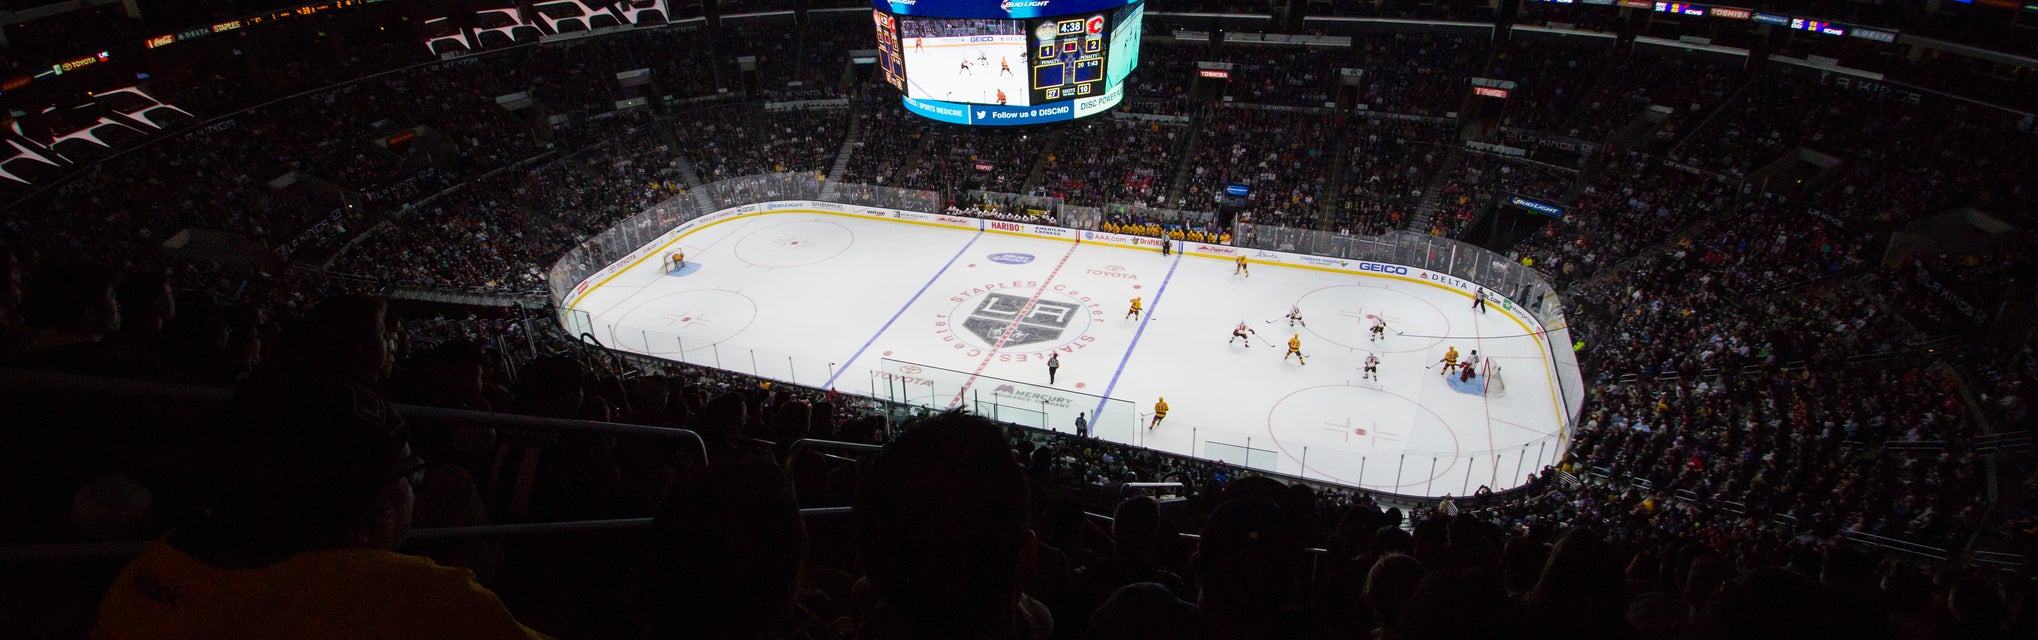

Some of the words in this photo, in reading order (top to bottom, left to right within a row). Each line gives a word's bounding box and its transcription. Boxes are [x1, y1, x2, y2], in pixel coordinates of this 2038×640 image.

[1711, 9, 1750, 18] TOSHIBA
[213, 21, 241, 32] STAPLES
[1060, 22, 1082, 33] 4:38
[1091, 41, 1097, 49] 2
[71, 57, 96, 68] TOYOTA
[1200, 70, 1229, 78] TOSHIBA
[1048, 90, 1057, 98] 27
[1080, 99, 1097, 110] DISC
[937, 106, 963, 117] MEDICINE
[992, 110, 1018, 119] Follow
[1039, 106, 1070, 116] DISCMD
[866, 208, 886, 217] verizon
[991, 221, 1020, 232] HARIBO
[1034, 226, 1067, 234] AMERICAN
[1094, 233, 1127, 243] AAA.com
[1140, 238, 1173, 248] DraftKis
[616, 254, 638, 268] TOYOTA
[1086, 268, 1137, 281] TOYOTA
[1359, 262, 1407, 276] GEICO
[1431, 273, 1468, 290] DELTA
[951, 280, 1038, 304] STAPLES
[1054, 283, 1104, 324] Center
[874, 371, 931, 387] TOYOTA
[1016, 390, 1073, 405] MERCURY
